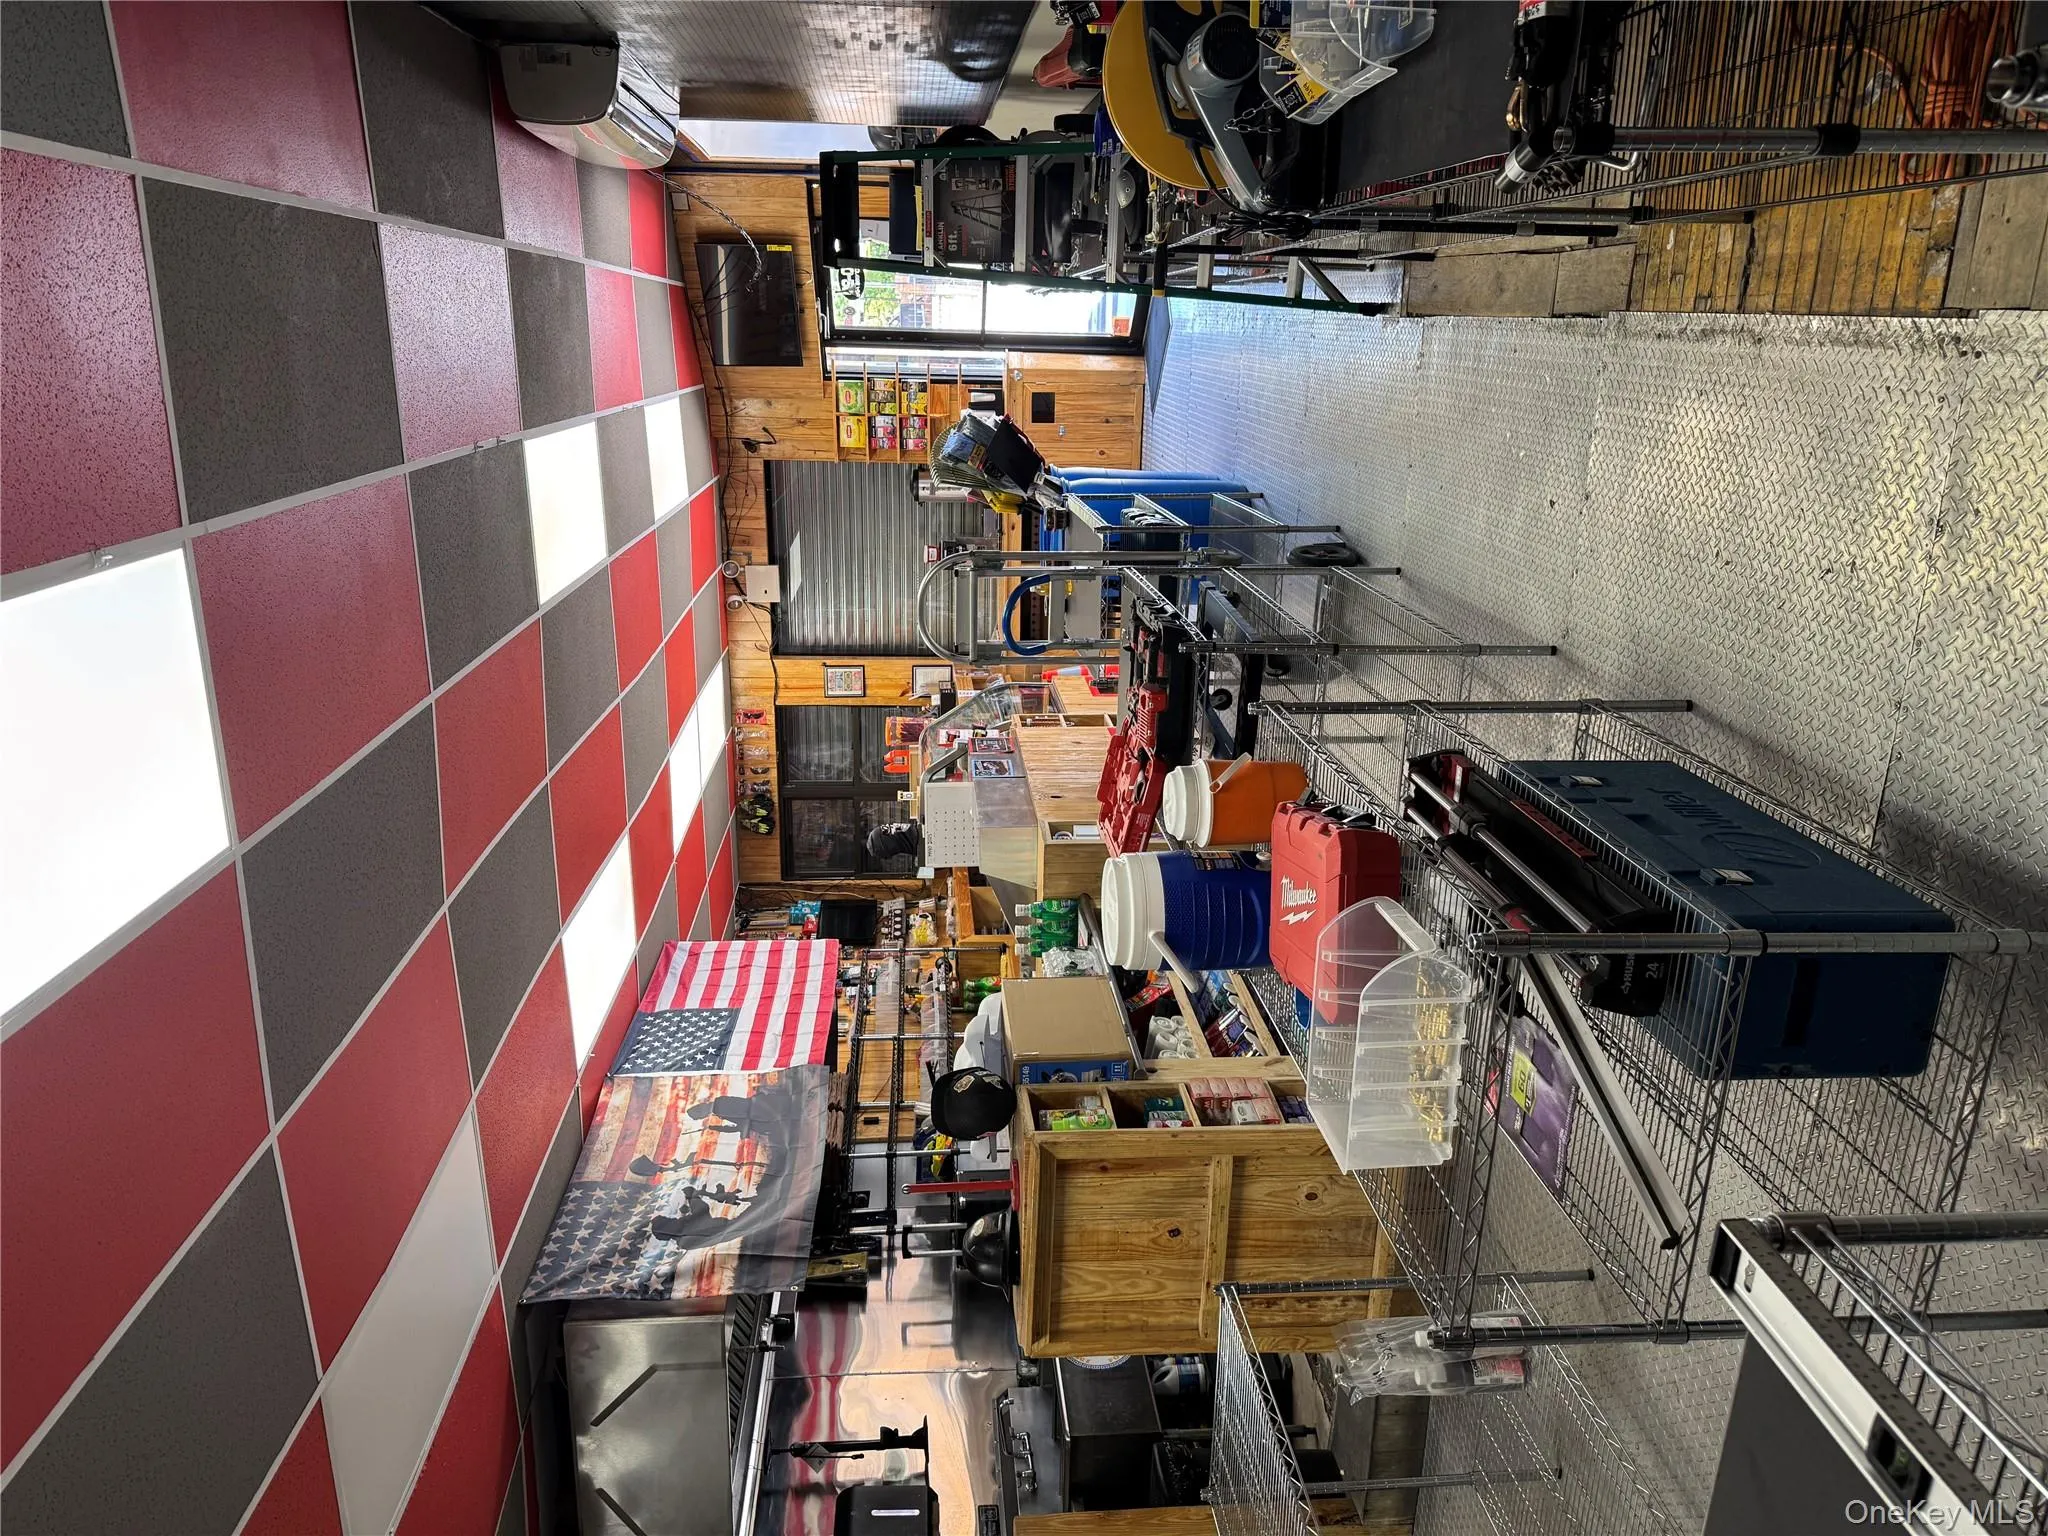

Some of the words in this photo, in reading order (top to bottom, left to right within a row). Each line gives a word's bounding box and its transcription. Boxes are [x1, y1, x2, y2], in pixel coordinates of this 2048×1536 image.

[948, 231, 958, 251] 6ft.
[1646, 788, 1741, 830] Miller
[1623, 953, 1635, 981] HUSK
[1646, 962, 1659, 978] 24
